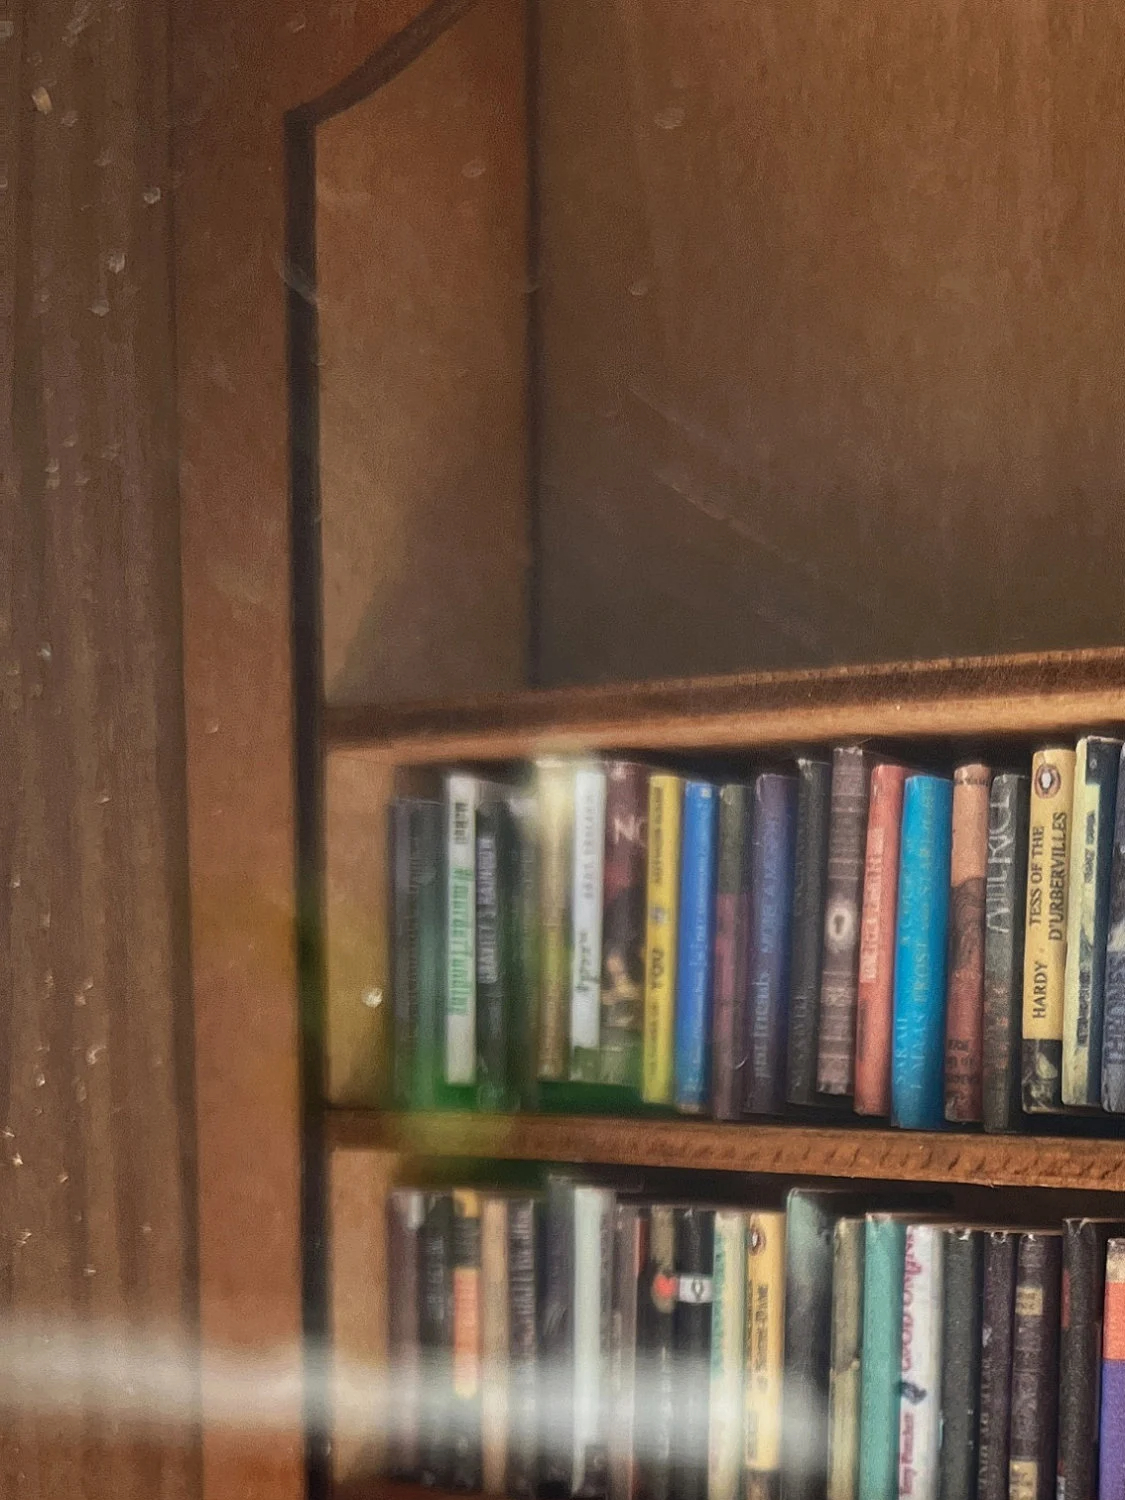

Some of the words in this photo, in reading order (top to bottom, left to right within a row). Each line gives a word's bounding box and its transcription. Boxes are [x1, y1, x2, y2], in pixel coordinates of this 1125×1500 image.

[1031, 826, 1046, 858] THE
[1030, 862, 1044, 884] OF
[1046, 811, 1069, 942] D'URBERVILLES
[1028, 887, 1043, 927] TESS
[1031, 961, 1048, 1020] HARDY
